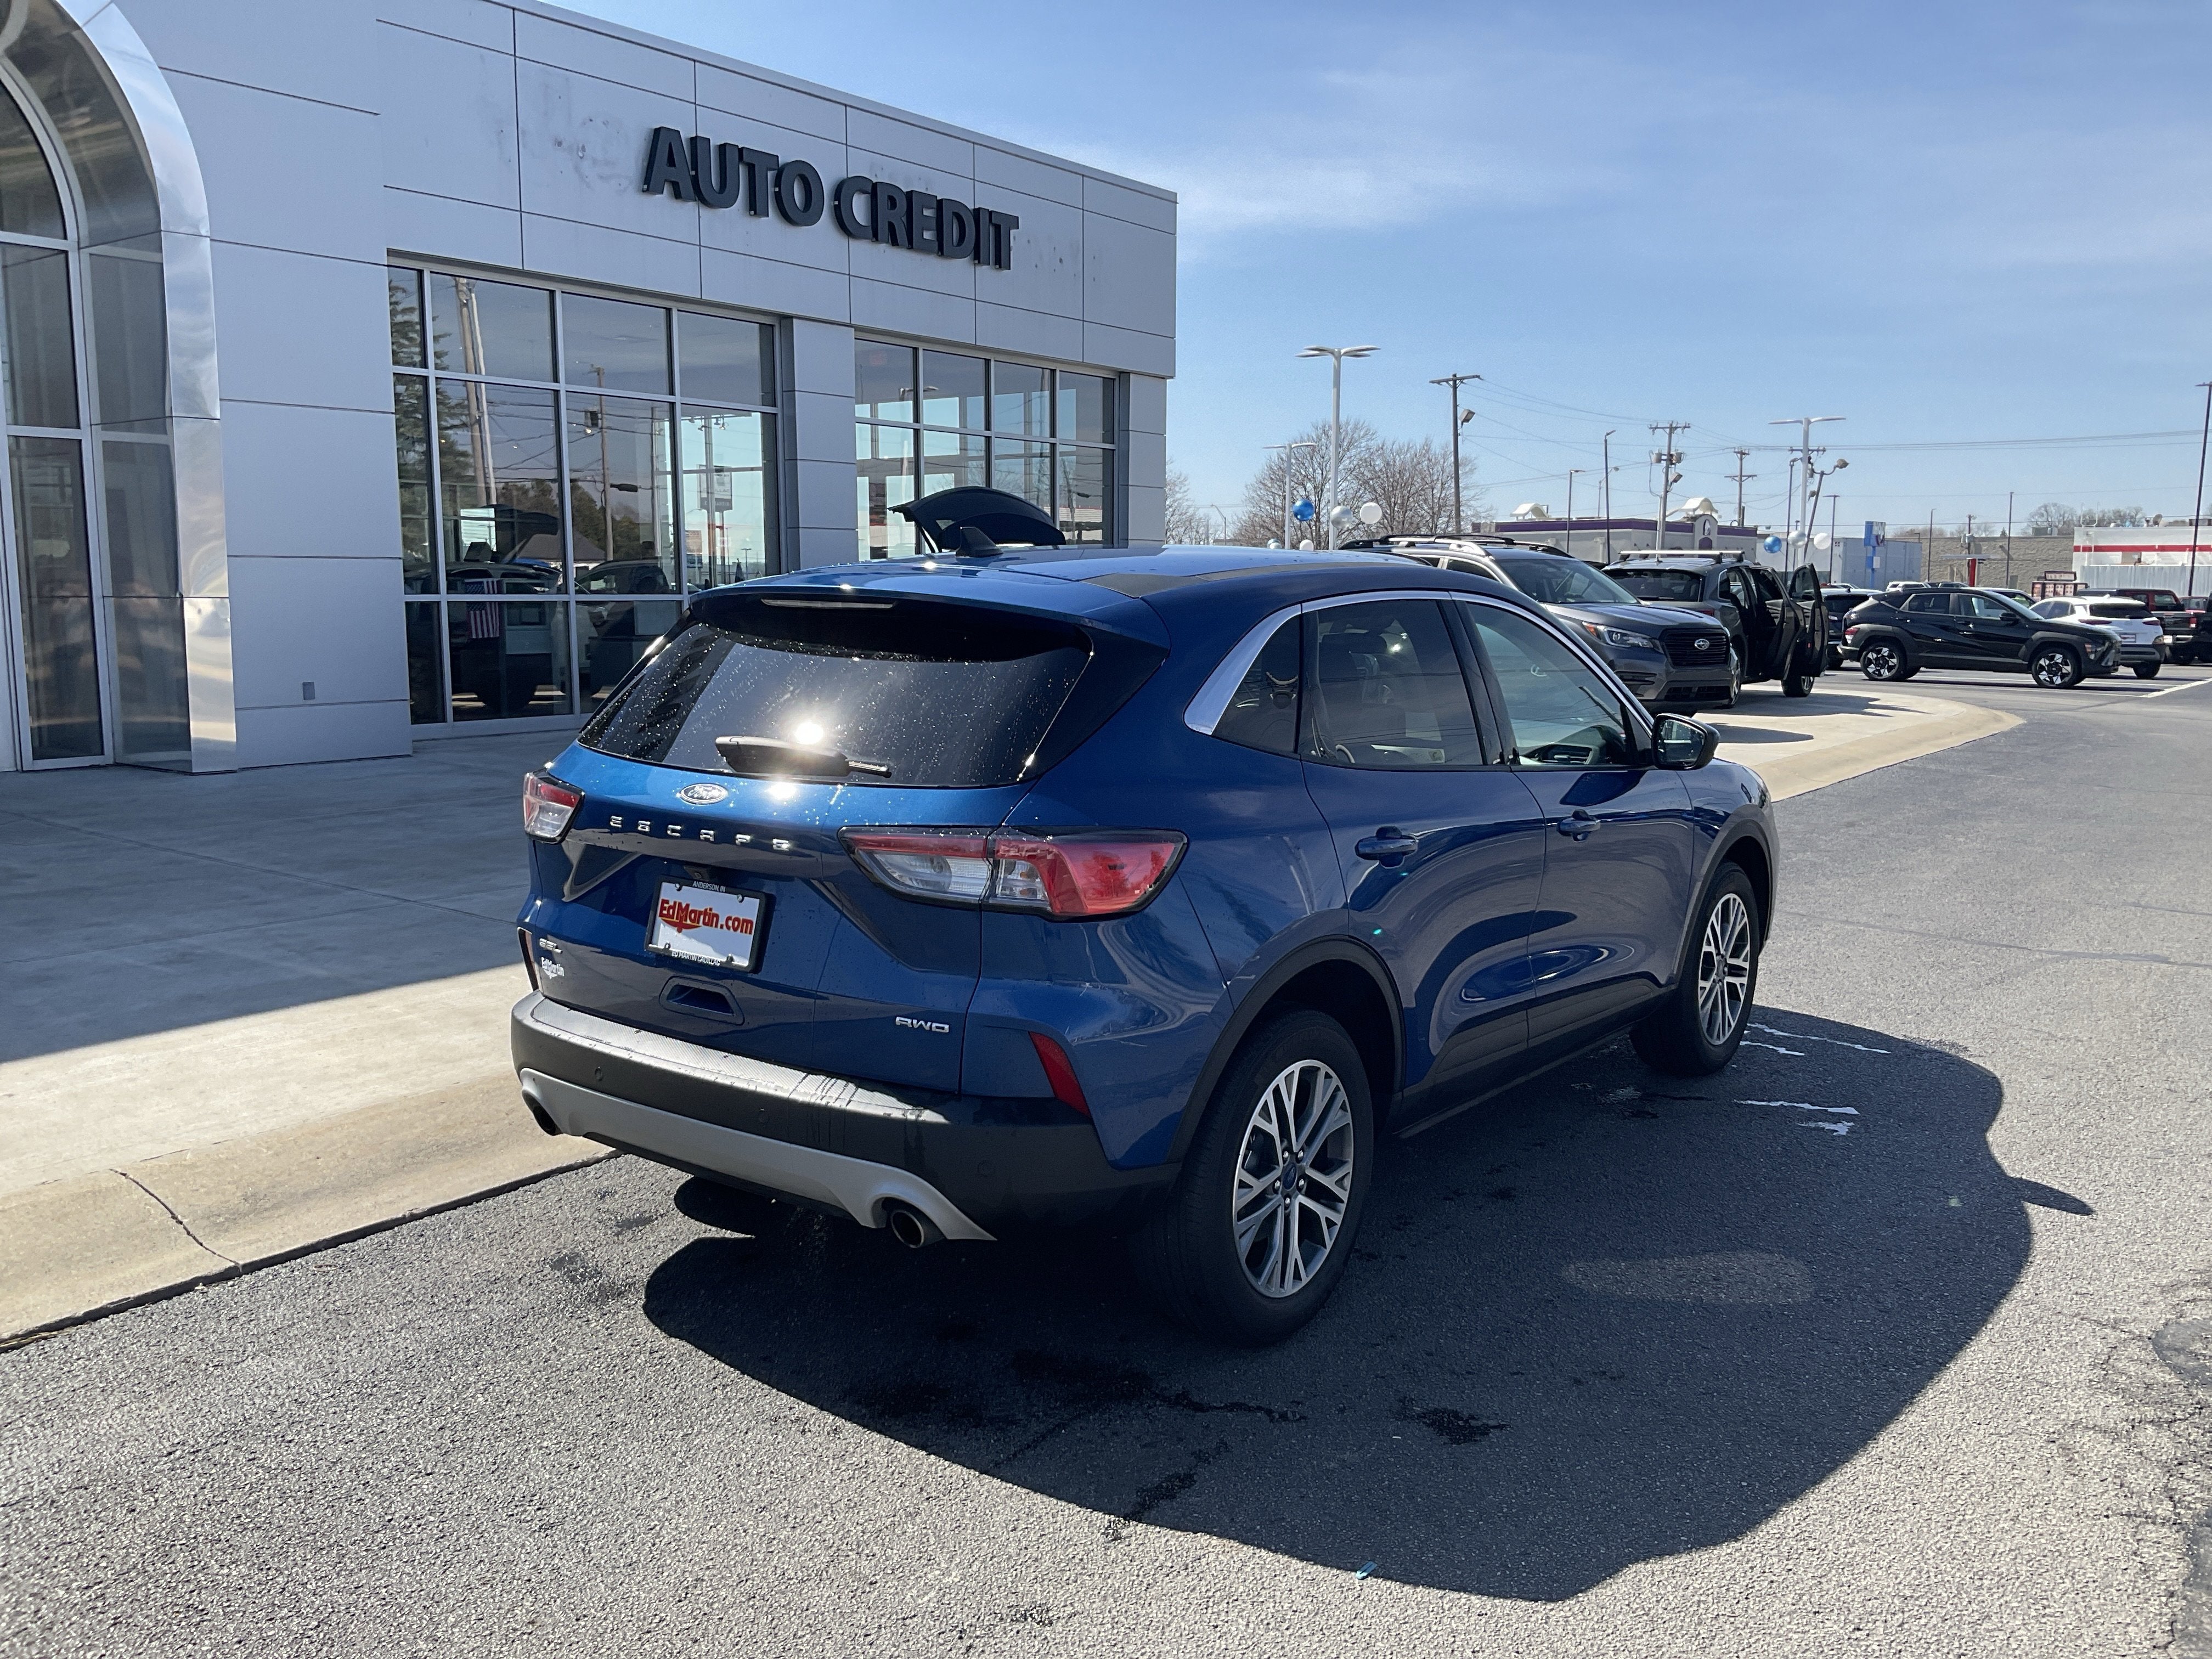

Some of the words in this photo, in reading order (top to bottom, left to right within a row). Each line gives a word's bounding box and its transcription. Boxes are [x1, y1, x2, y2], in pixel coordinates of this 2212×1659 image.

[642, 126, 825, 226] AUTO
[833, 176, 1019, 270] CREDIT
[610, 816, 790, 851] ESCAPE
[659, 899, 754, 935] EdMartin.com
[679, 952, 697, 961] MARTIN
[698, 956, 721, 966] CADILLAC
[895, 1017, 950, 1032] AWD
